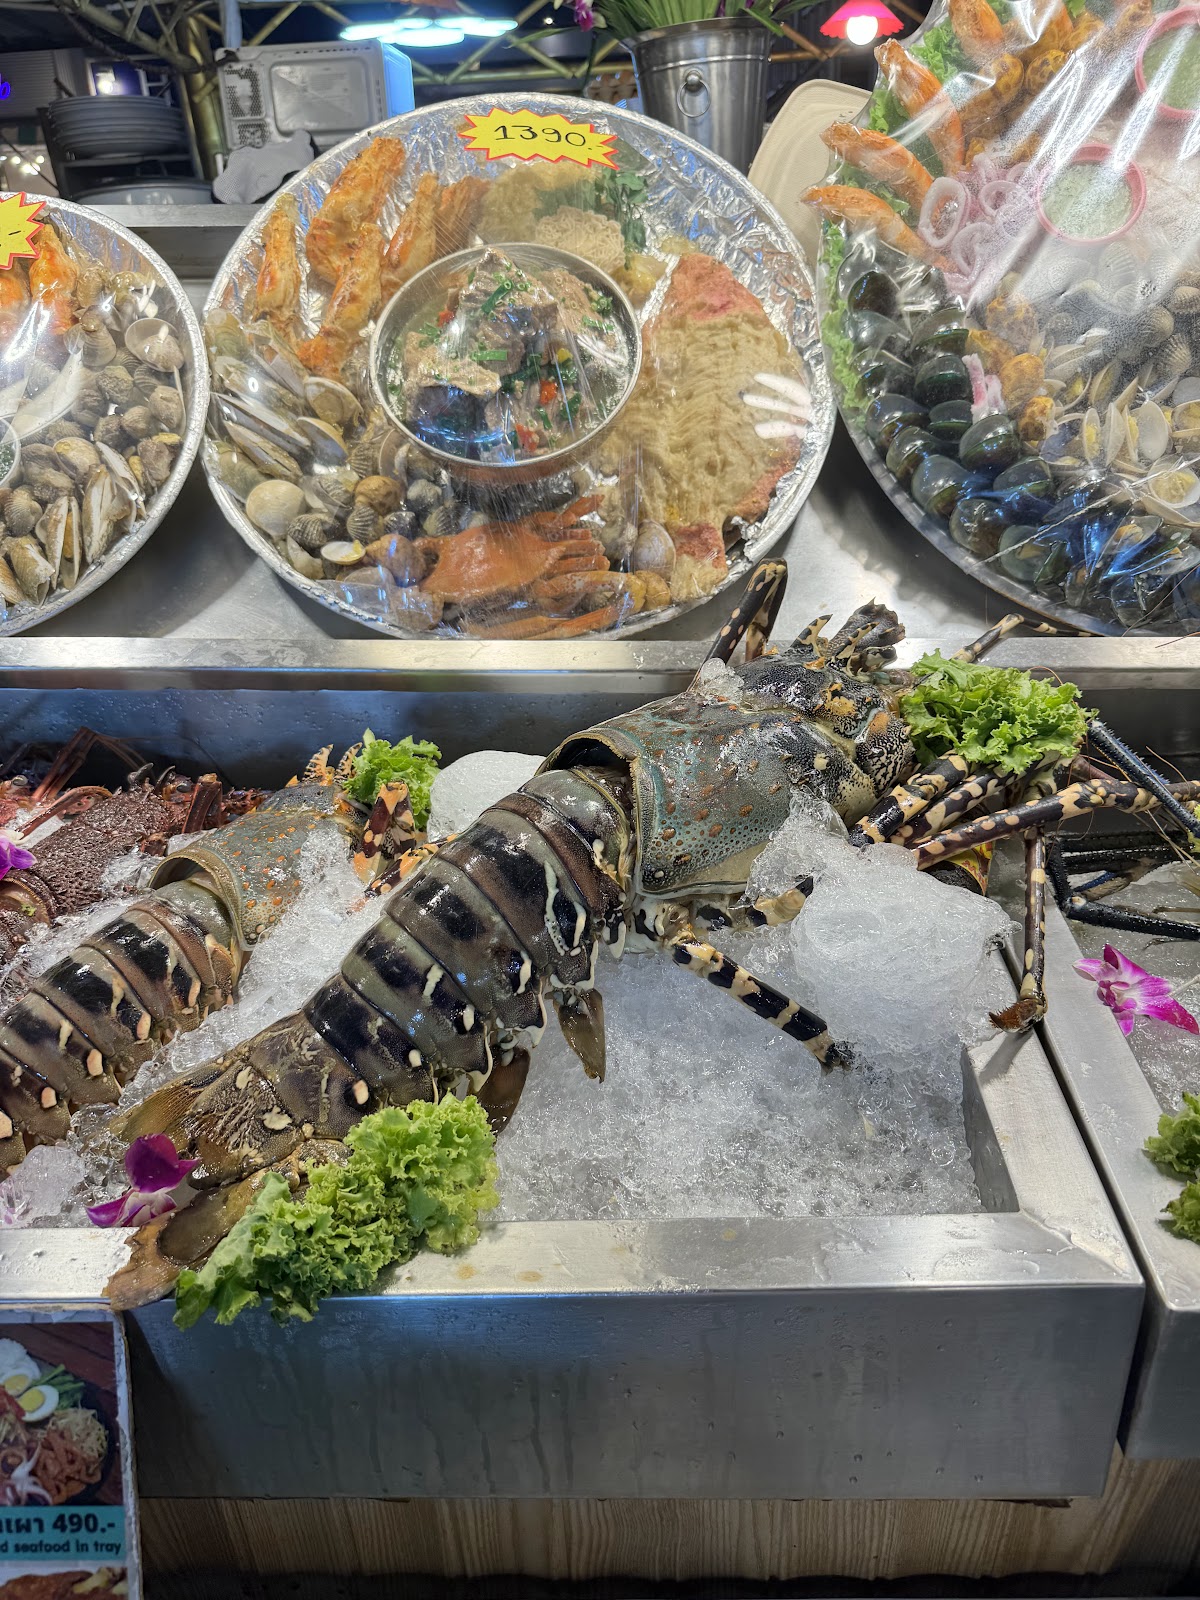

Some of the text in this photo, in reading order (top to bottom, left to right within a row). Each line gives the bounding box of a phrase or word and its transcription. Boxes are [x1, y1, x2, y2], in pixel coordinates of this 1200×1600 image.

[52, 1512, 116, 1533] 490.-
[14, 1539, 70, 1553] seafood
[94, 1540, 122, 1555] tray
